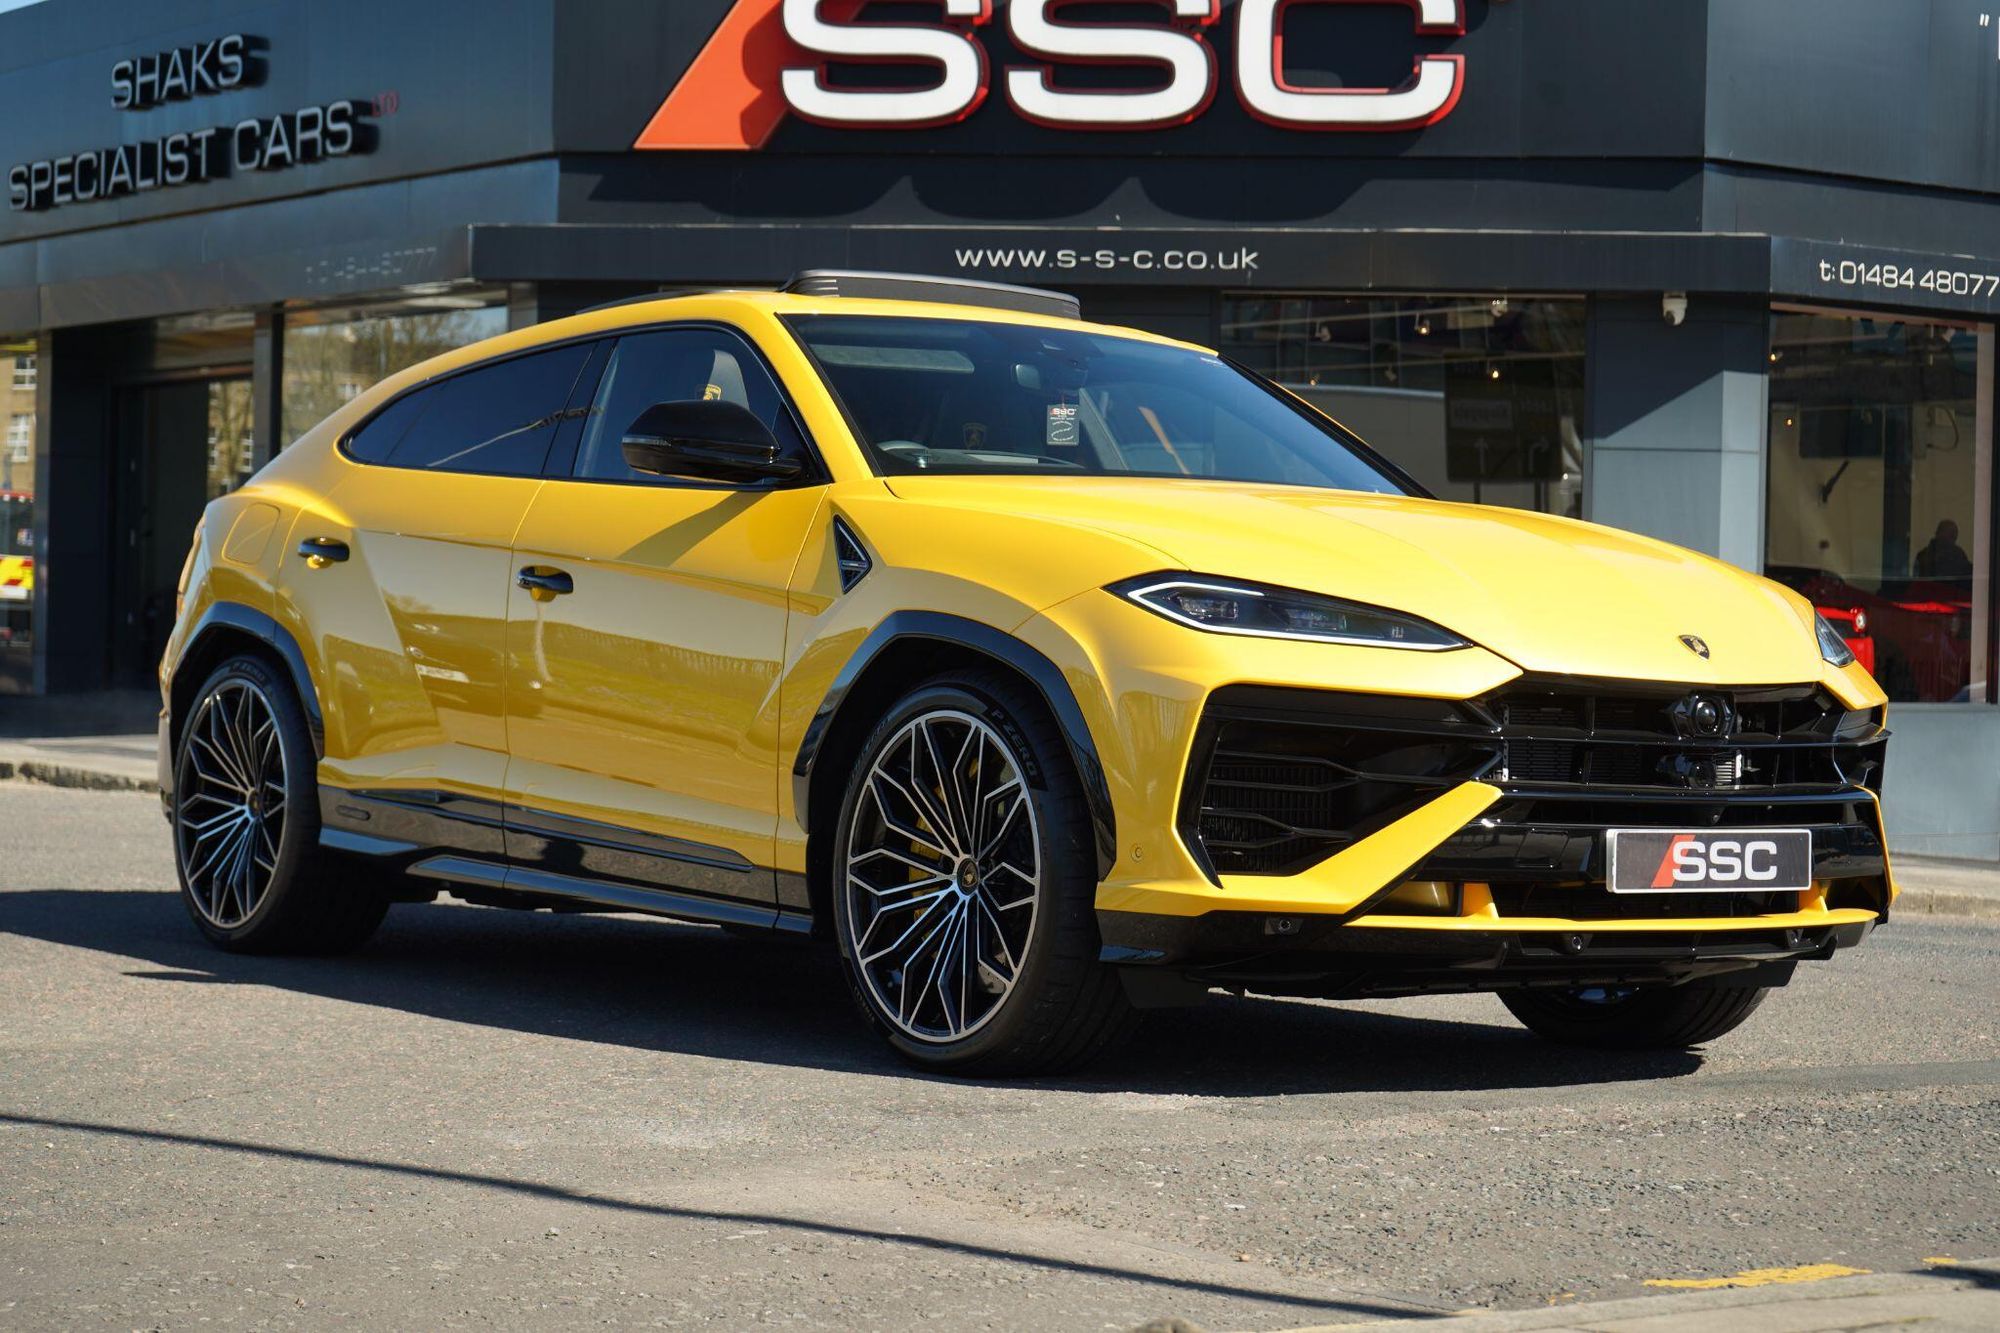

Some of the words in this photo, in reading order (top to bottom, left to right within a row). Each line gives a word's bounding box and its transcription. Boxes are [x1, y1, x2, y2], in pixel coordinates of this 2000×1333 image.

[110, 34, 245, 109] SHAKS
[780, 0, 1463, 128] SSC
[8, 128, 216, 211] SPECIALIST
[233, 100, 354, 171] CARS
[954, 247, 1259, 270] www.s-s-c.co.uk
[1672, 841, 1778, 882] SSC
